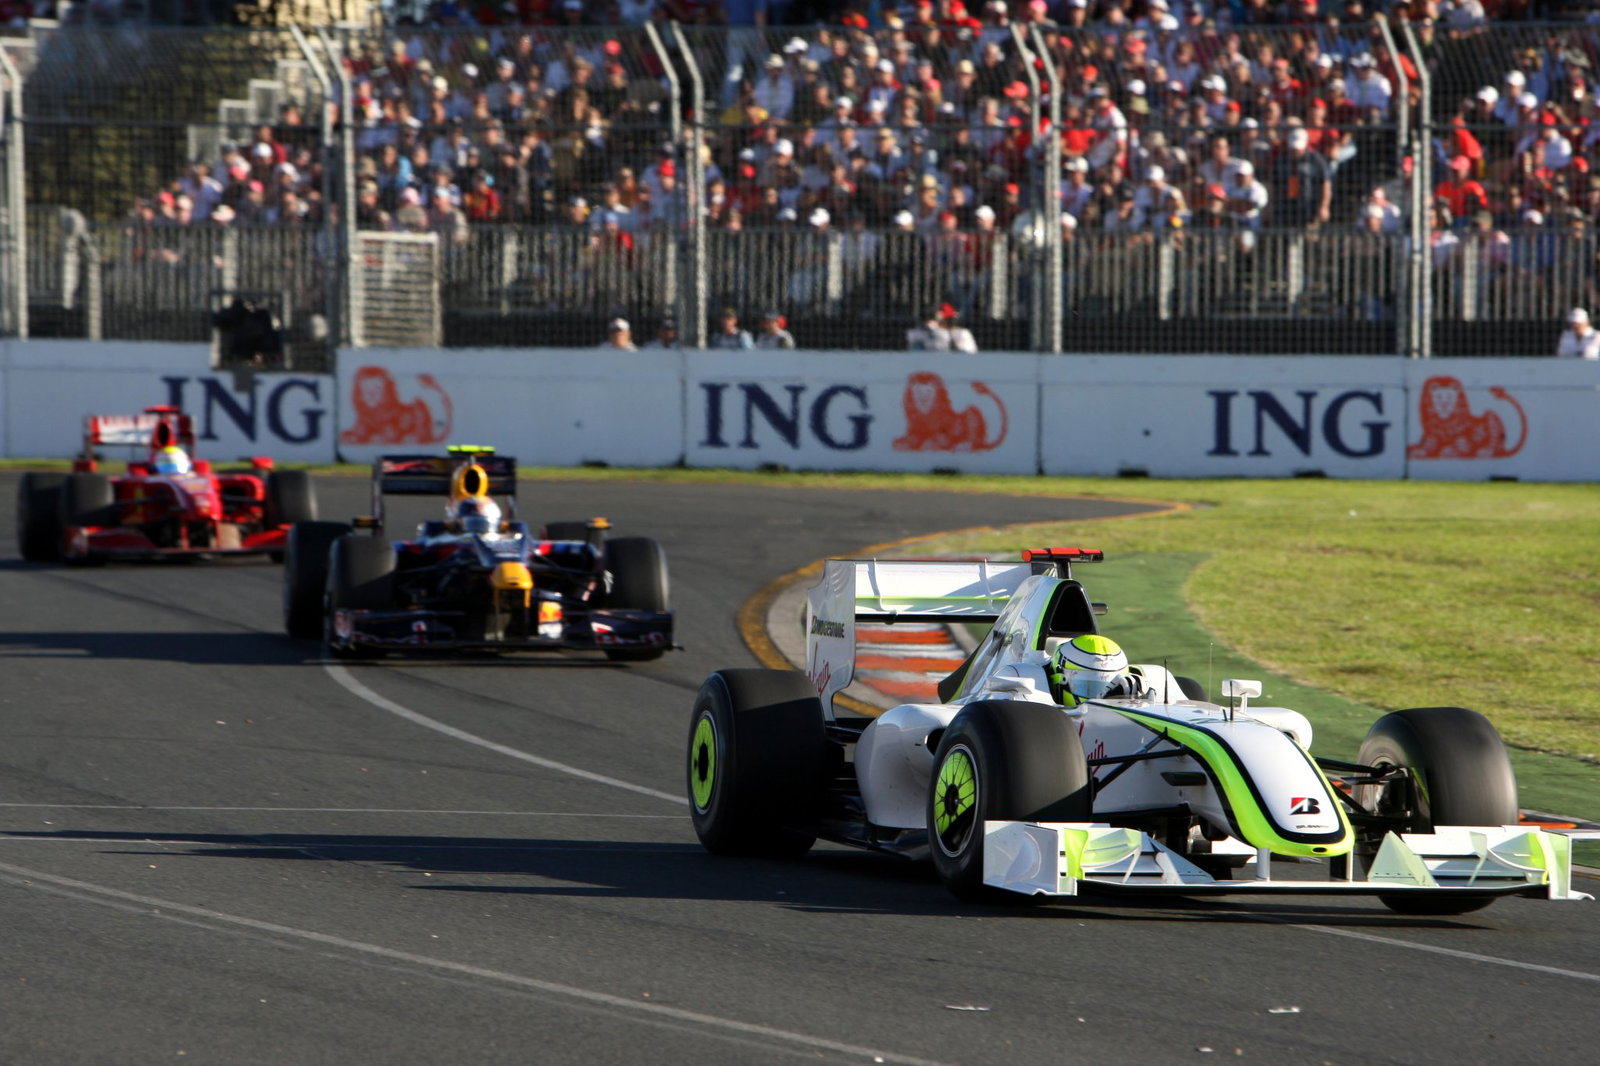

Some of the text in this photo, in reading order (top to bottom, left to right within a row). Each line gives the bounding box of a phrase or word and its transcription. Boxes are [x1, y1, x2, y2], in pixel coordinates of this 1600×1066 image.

[161, 377, 327, 445] ING
[699, 382, 875, 452] ING
[1206, 390, 1392, 459] ING
